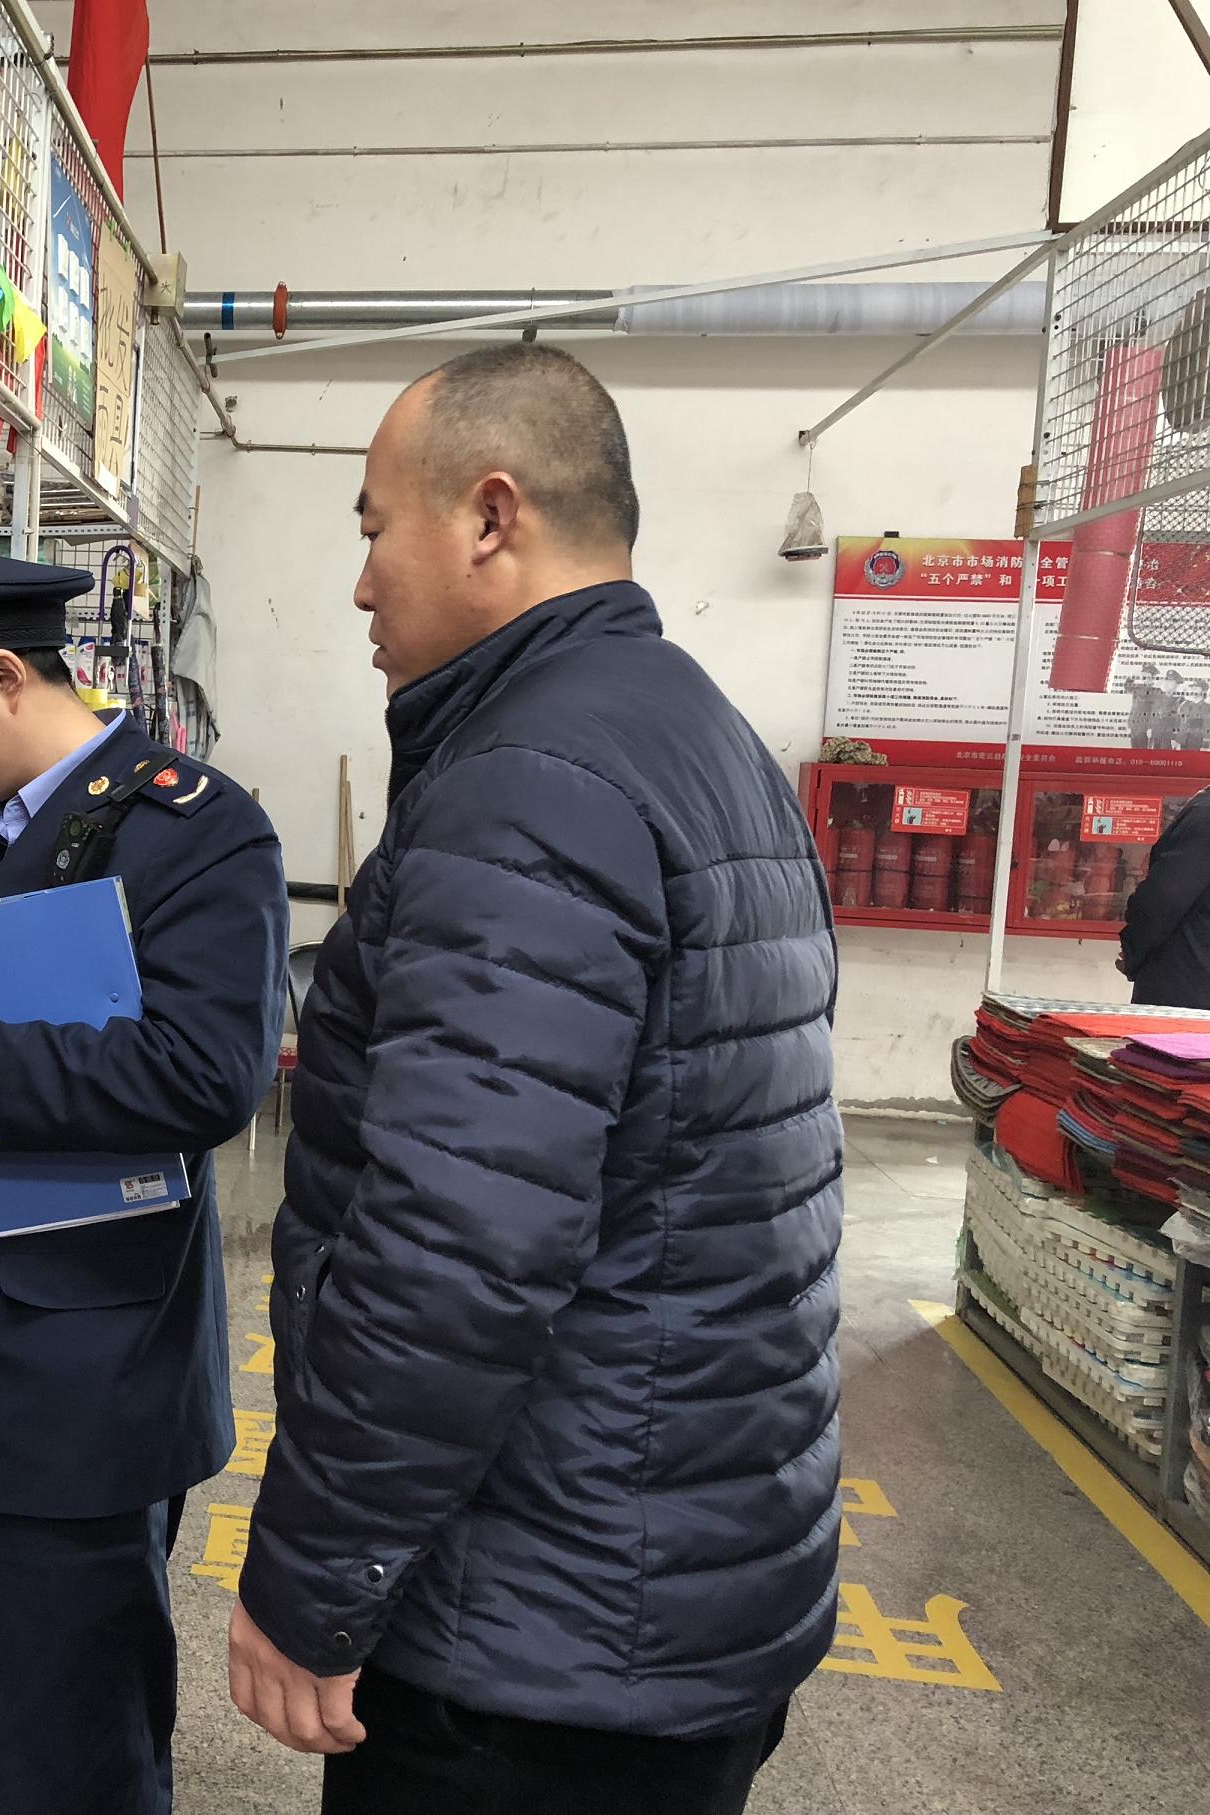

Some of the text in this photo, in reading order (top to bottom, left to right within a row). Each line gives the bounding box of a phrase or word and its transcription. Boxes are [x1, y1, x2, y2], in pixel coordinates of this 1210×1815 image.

[922, 554, 1070, 570] 北京市市场消防全管
[999, 574, 1012, 586] 和
